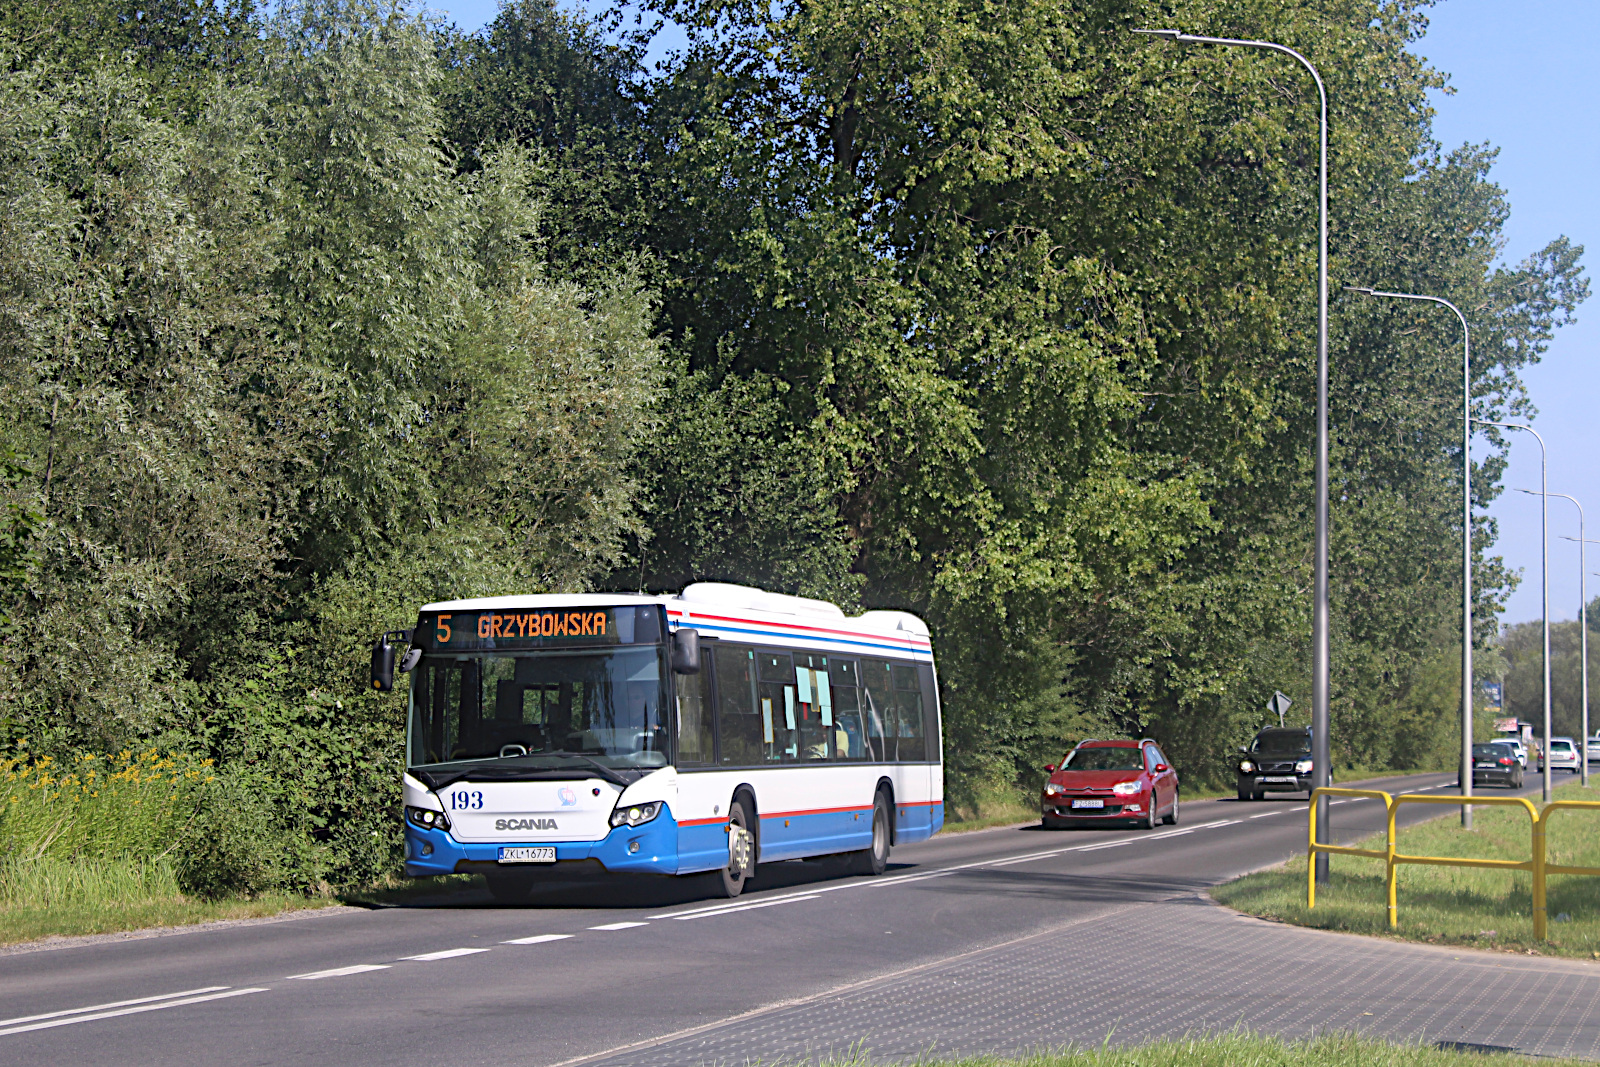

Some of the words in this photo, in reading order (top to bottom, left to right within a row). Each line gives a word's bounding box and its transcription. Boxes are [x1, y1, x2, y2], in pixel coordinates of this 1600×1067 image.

[436, 614, 452, 643] 5
[477, 612, 607, 638] GRZYBOWSKA
[450, 790, 484, 810] 193
[495, 818, 558, 831] SCANIA
[504, 849, 522, 859] ZKL
[526, 848, 554, 859] 16773
